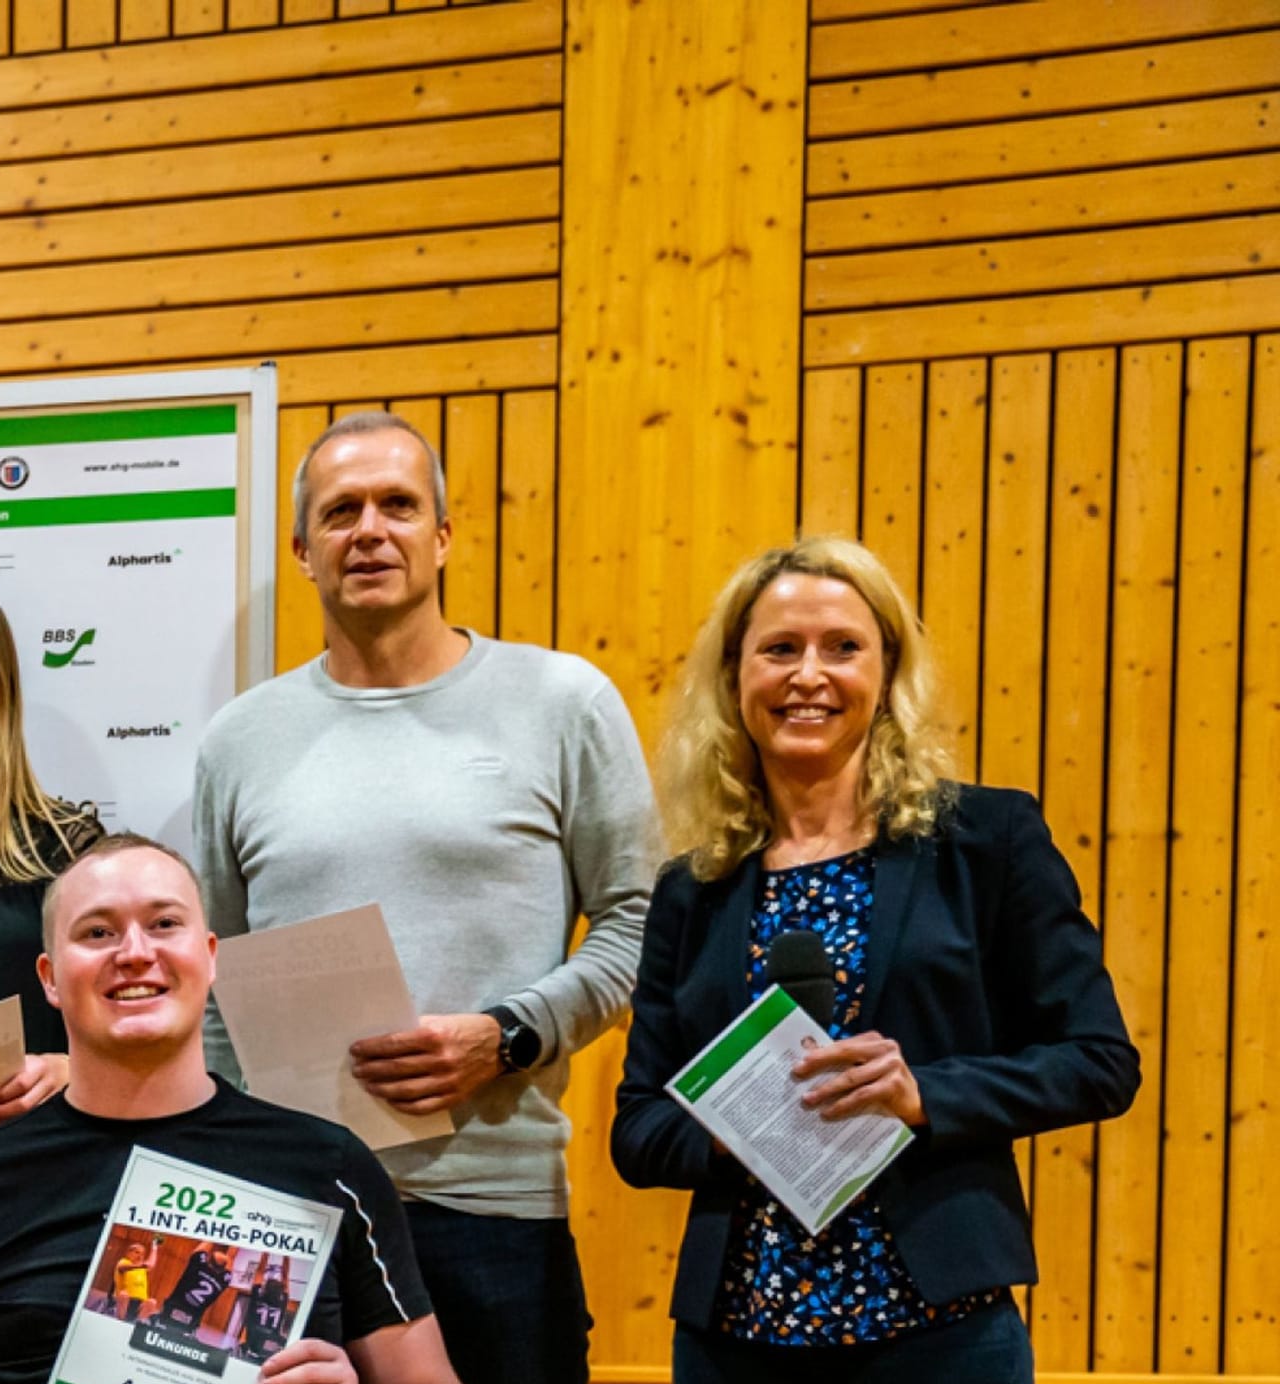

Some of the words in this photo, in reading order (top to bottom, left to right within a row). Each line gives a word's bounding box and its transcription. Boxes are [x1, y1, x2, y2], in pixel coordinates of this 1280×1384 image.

[83, 458, 180, 474] www.ahg-mobile.de
[107, 552, 172, 568] Alphartis
[42, 629, 76, 644] BBS
[106, 724, 171, 740] Alphartis
[155, 1182, 236, 1220] 2022
[128, 1206, 144, 1224] 1.
[149, 1210, 188, 1232] INT.
[193, 1219, 318, 1255] AHG-POKAL
